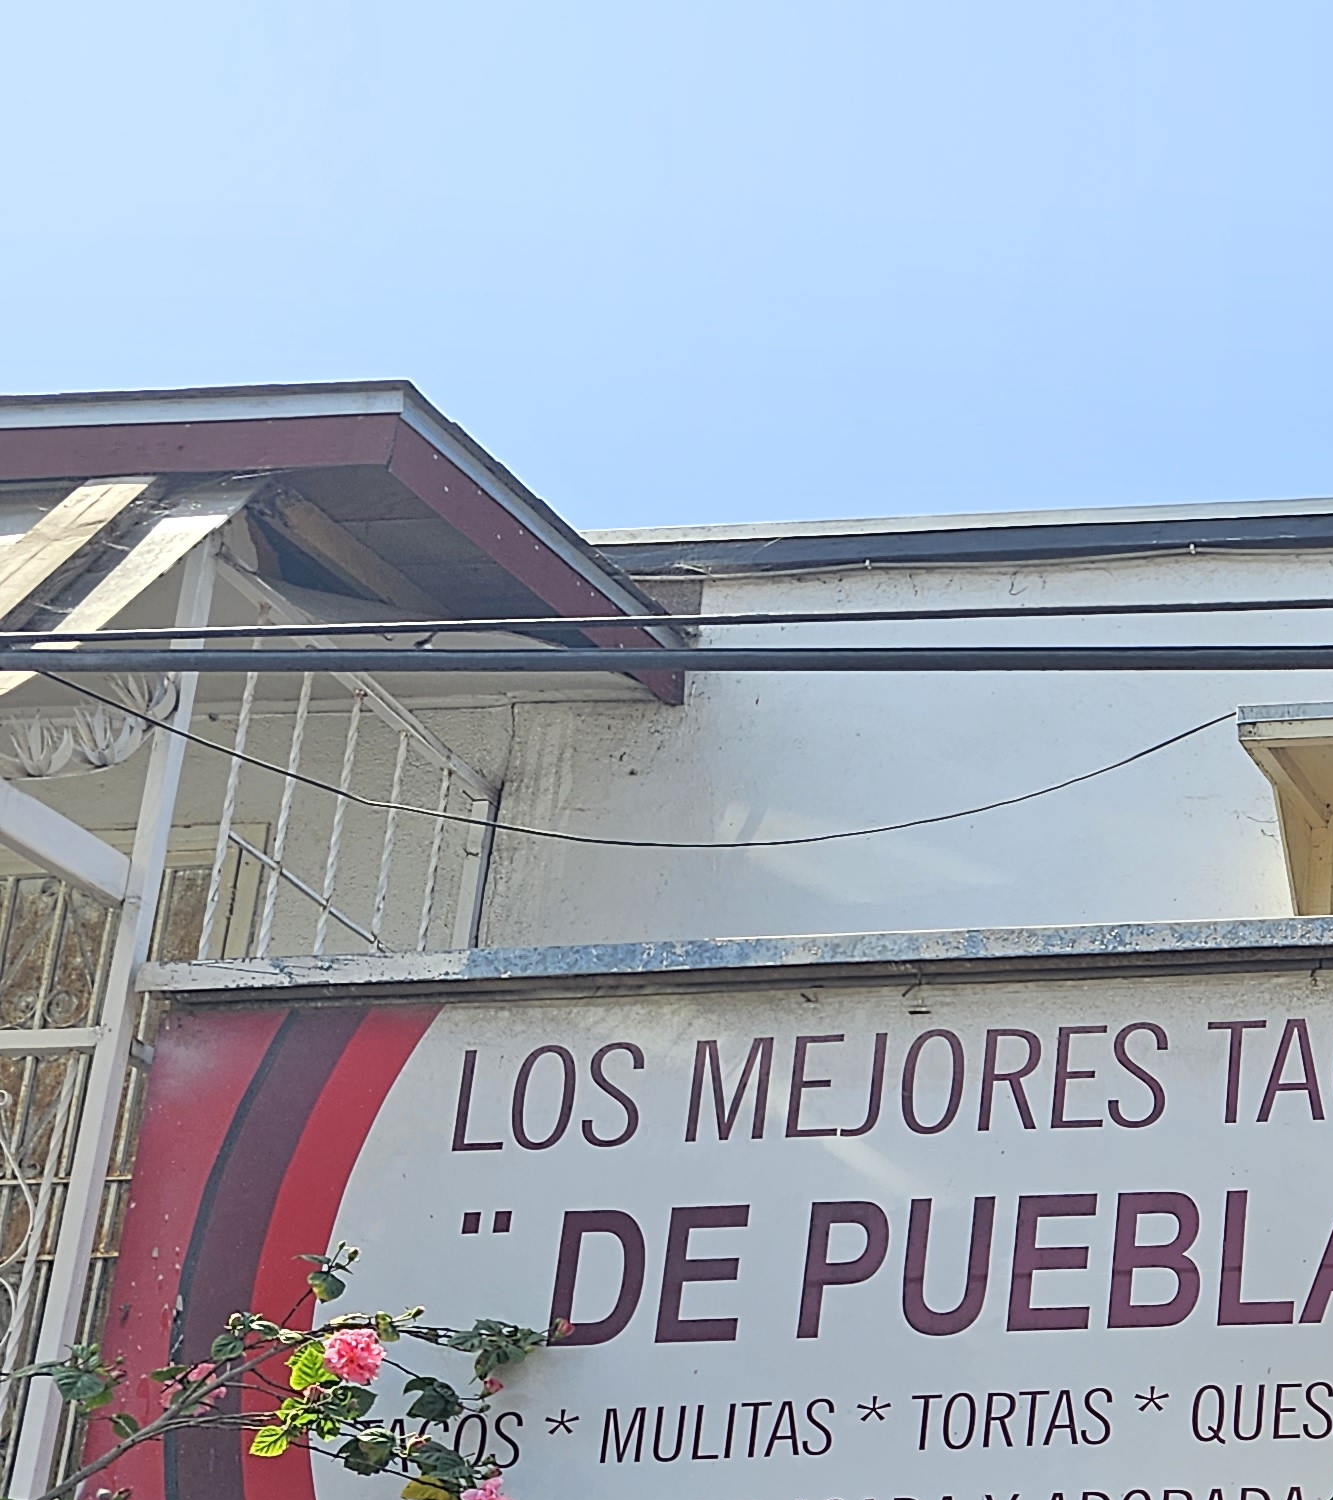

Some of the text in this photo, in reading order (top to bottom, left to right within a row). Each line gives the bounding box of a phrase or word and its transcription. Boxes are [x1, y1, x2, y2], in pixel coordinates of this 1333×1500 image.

[451, 1041, 645, 1152] LOS
[685, 1021, 1168, 1143] MEJORES
[546, 1204, 751, 1347] DE
[599, 1398, 834, 1464] MULITAS
[911, 1387, 1113, 1452] TORTAS
